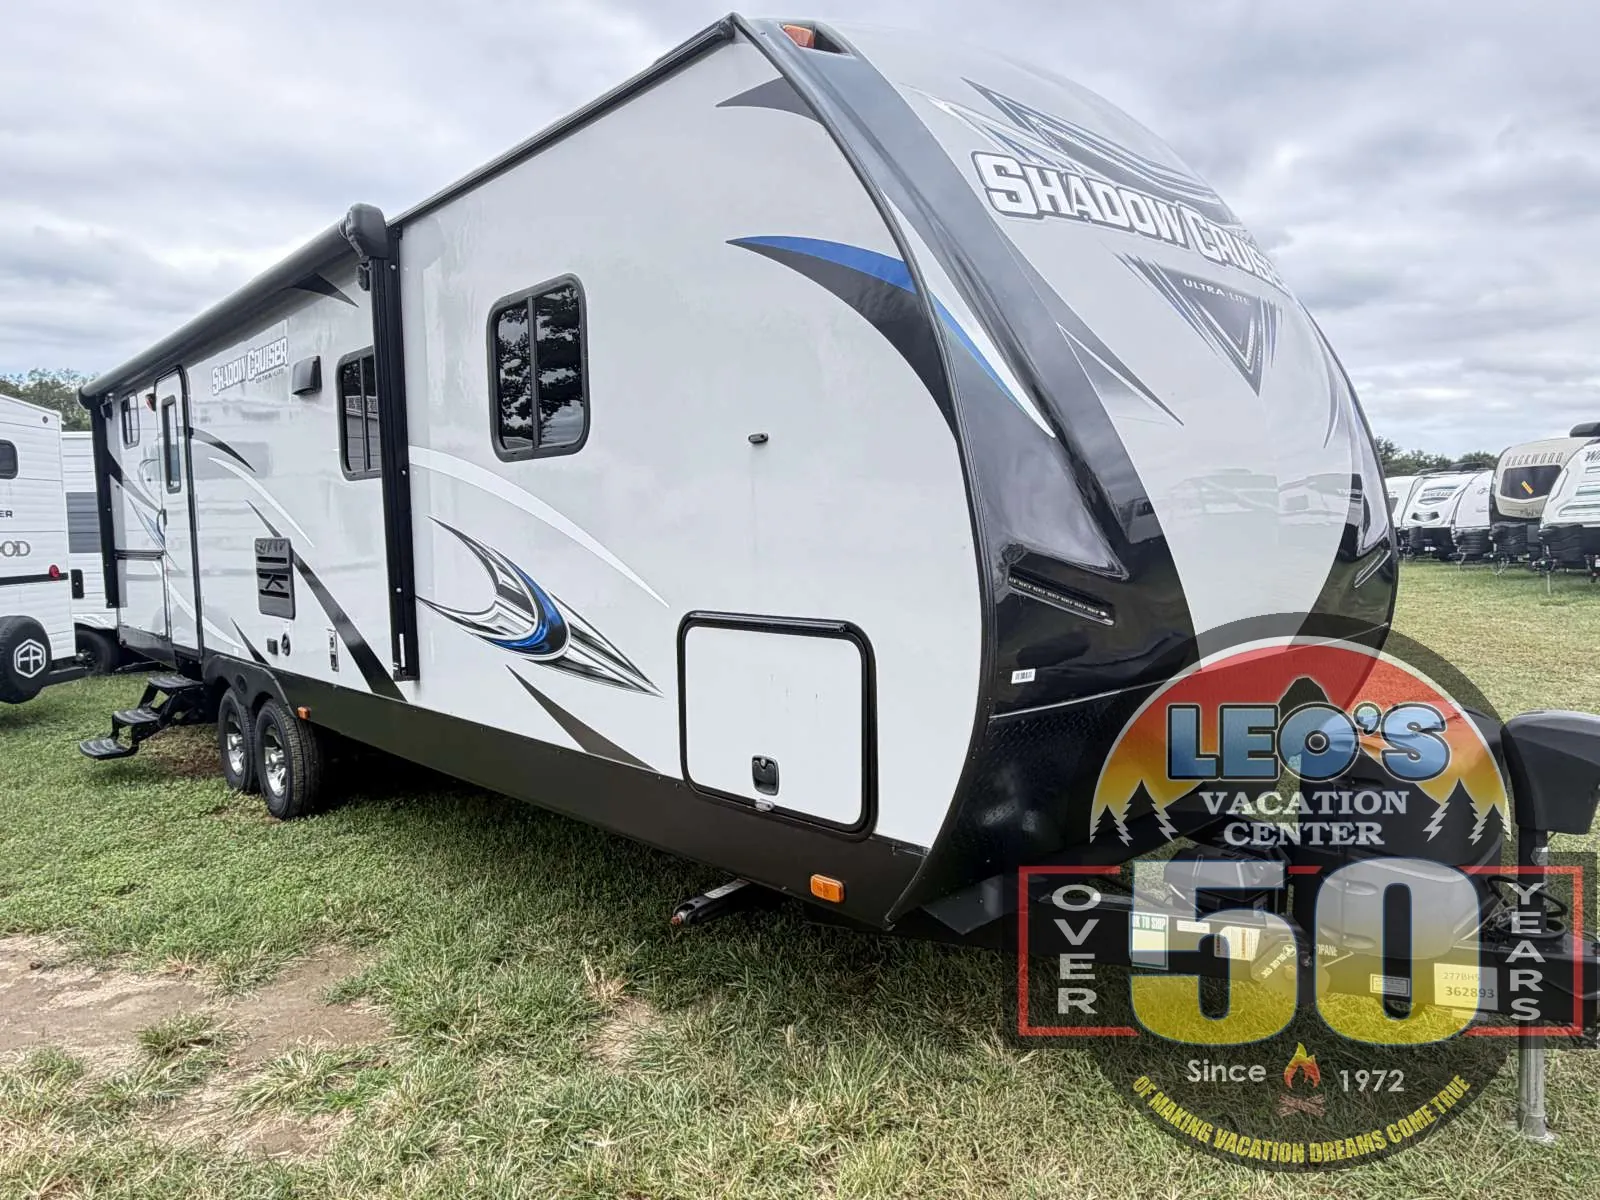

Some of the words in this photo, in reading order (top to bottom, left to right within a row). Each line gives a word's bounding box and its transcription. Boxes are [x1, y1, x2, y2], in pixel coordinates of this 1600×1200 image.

[971, 151, 1190, 250] SHADOW
[1183, 279, 1226, 297] ULTRA
[212, 355, 247, 396] SHADOW
[247, 336, 288, 381] CRUISER
[1445, 986, 1494, 999] 362893
